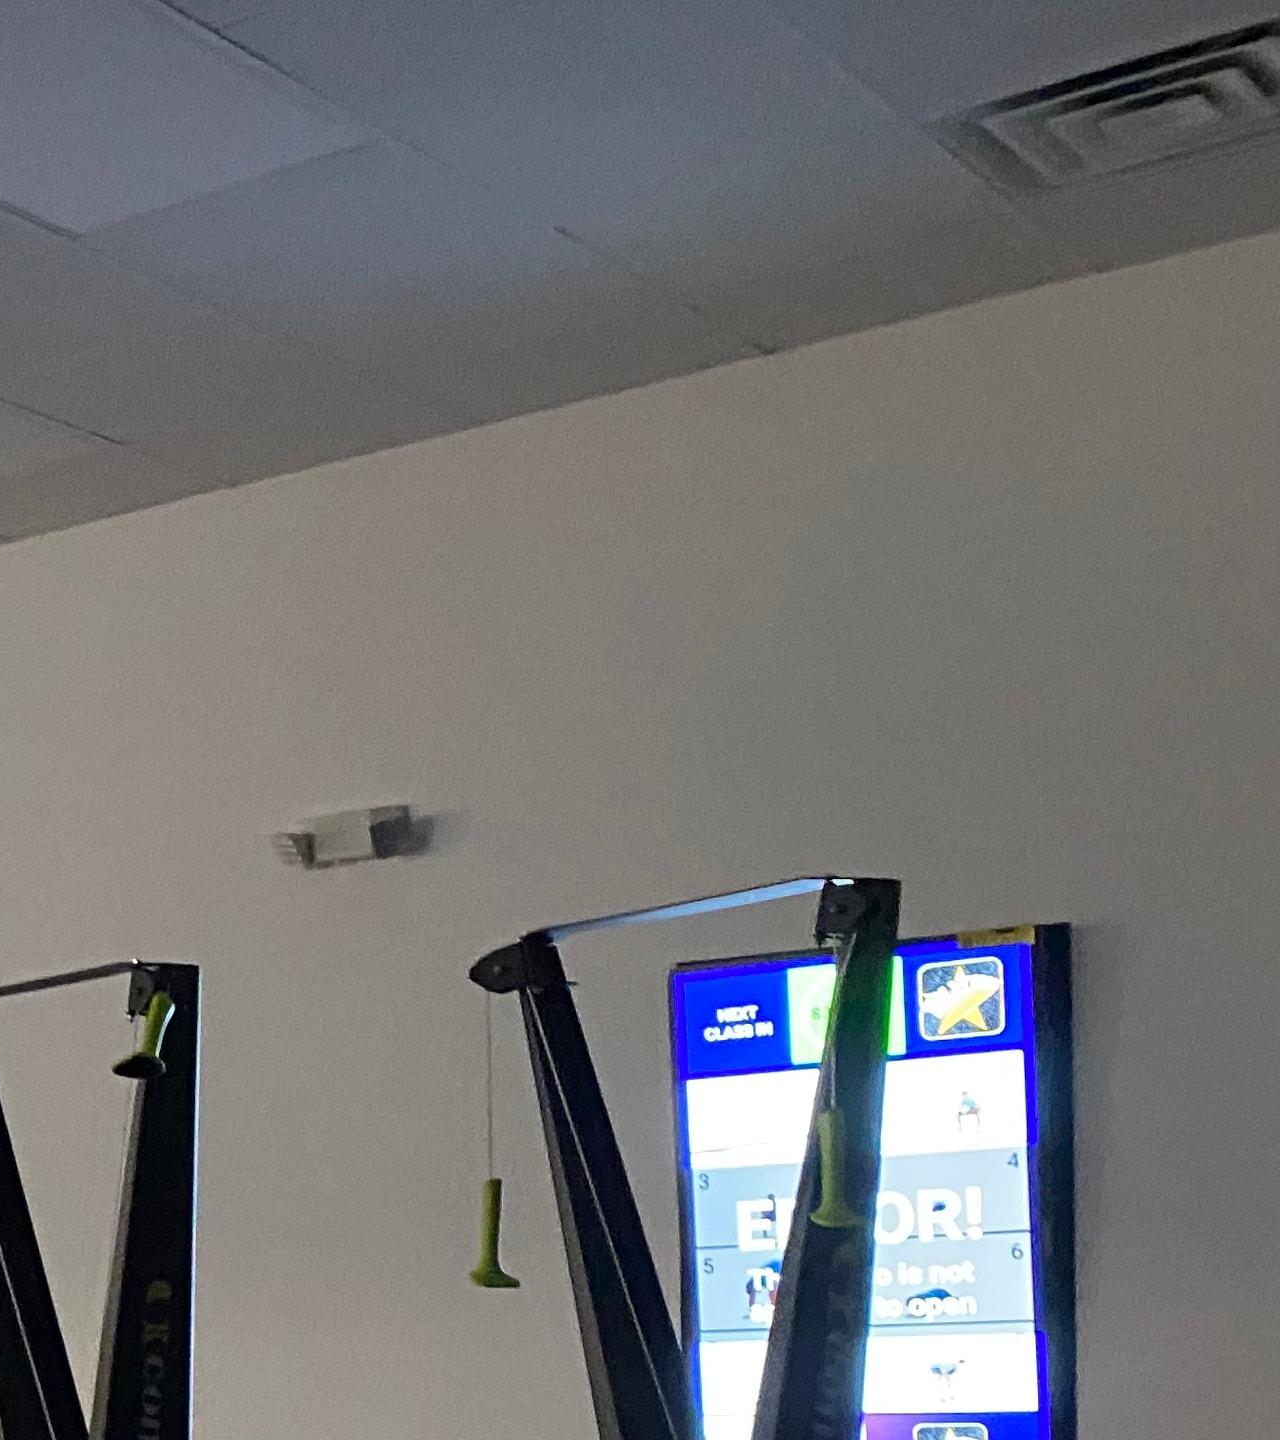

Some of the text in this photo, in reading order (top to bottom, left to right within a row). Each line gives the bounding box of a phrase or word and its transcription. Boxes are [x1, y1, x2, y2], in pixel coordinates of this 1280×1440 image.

[717, 1005, 759, 1023] NEXT
[704, 1023, 754, 1042] CLASS
[737, 1186, 983, 1251] EOR!
[1011, 1243, 1023, 1260] 6
[703, 1258, 715, 1275] 5
[897, 1261, 923, 1285] is
[928, 1259, 976, 1285] not
[907, 1295, 978, 1322] open
